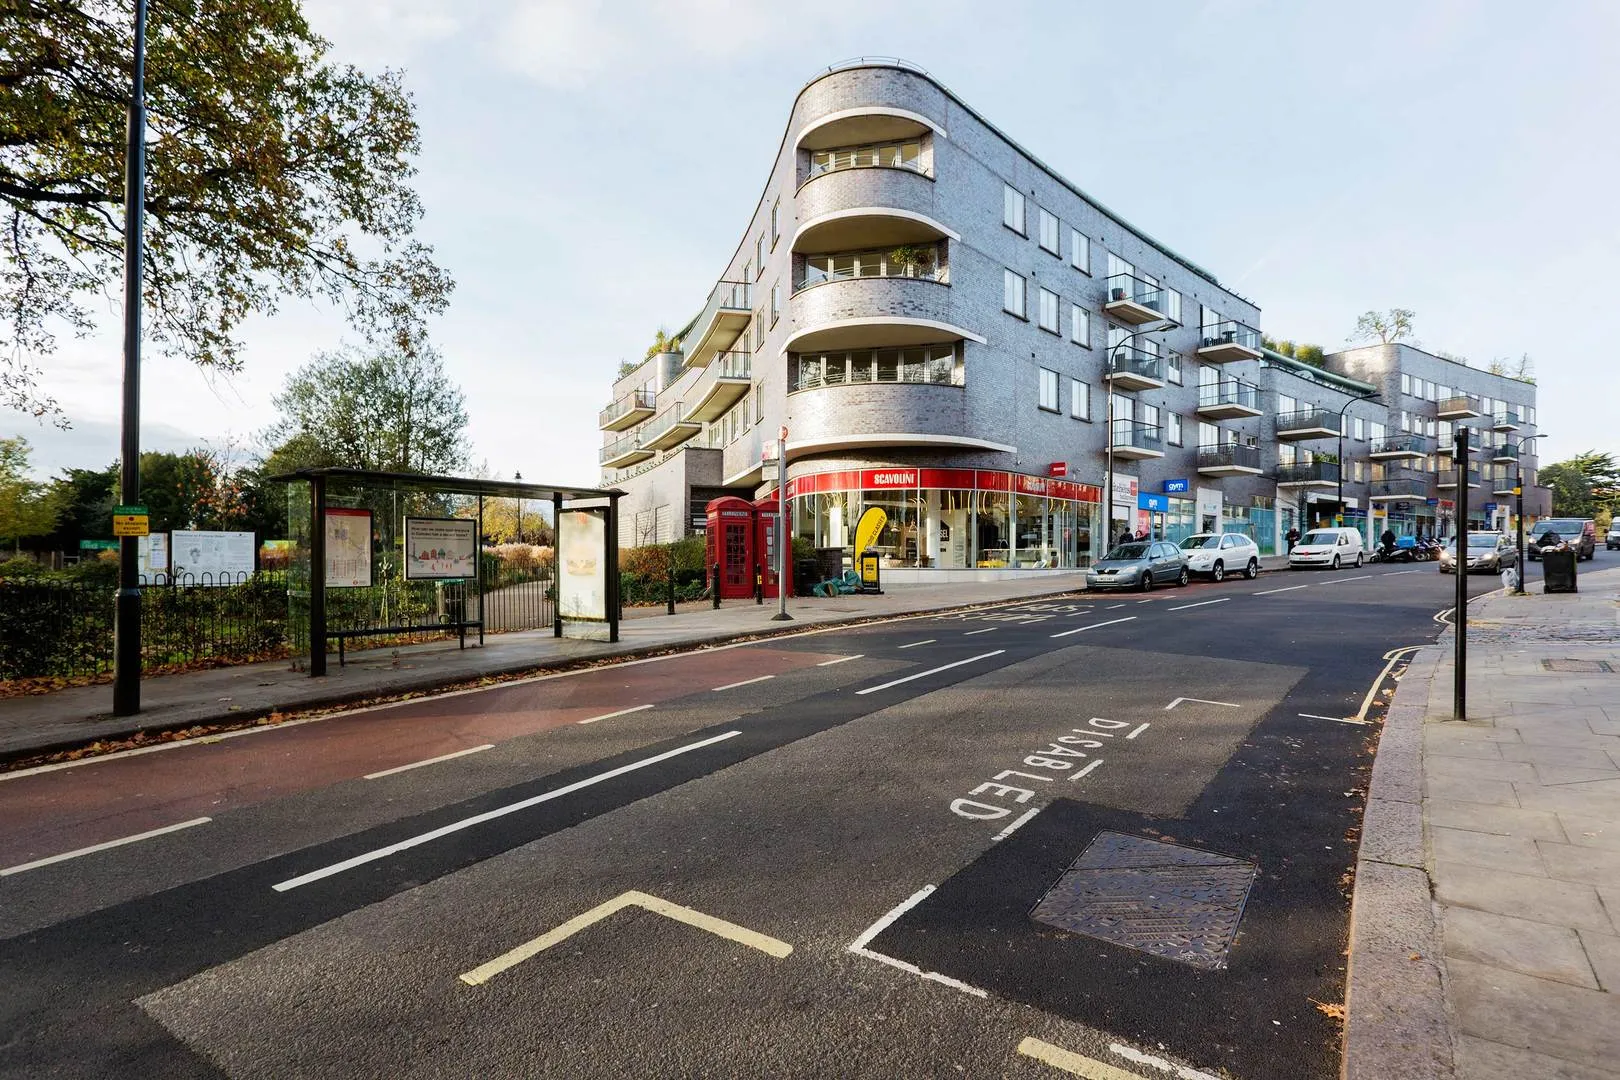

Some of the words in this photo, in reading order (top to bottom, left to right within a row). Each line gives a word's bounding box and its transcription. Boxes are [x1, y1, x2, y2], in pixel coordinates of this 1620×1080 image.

[874, 473, 914, 484] SCAVOLINI
[1168, 483, 1184, 491] gym
[950, 717, 1130, 820] DISABLED
